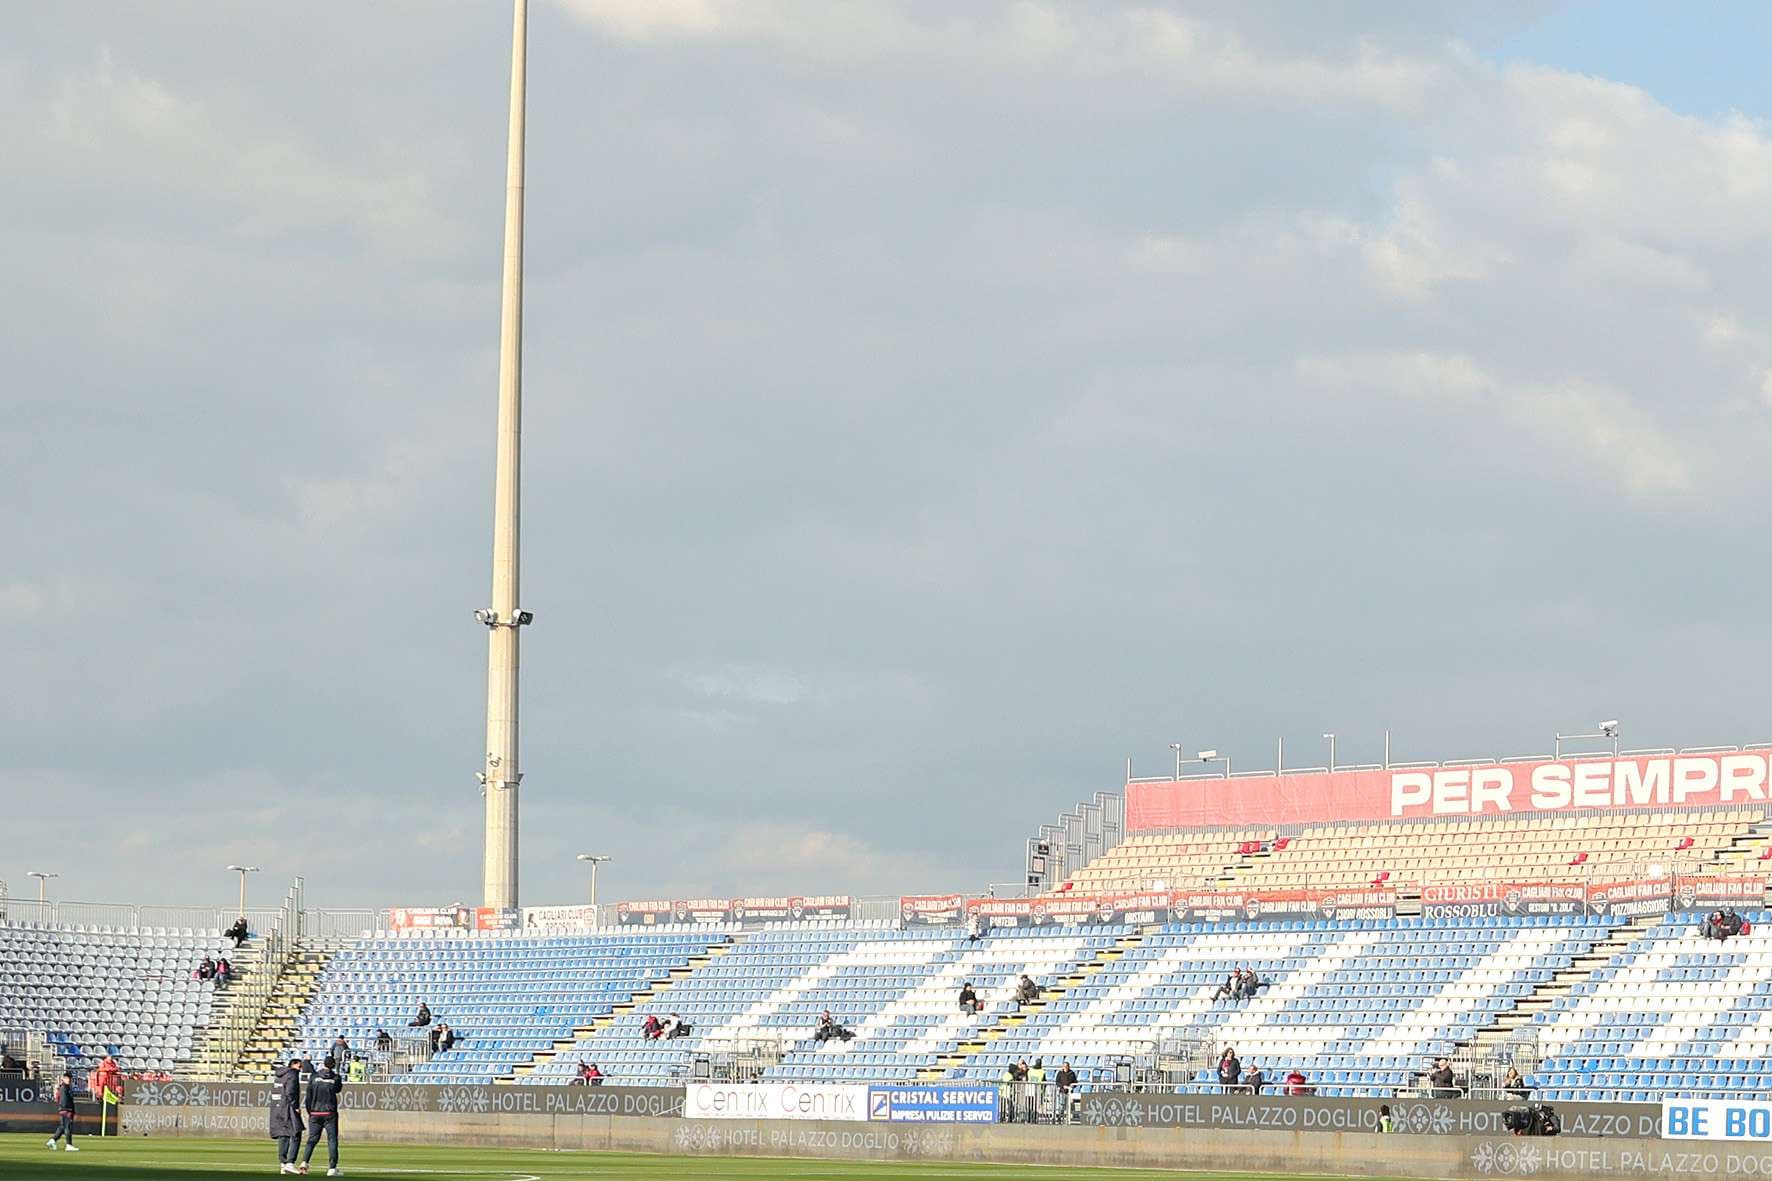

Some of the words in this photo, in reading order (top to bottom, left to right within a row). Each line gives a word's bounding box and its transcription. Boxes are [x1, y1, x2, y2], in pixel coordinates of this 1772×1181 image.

[1390, 769, 1513, 816] PER
[1424, 886, 1497, 901] GIURISTI
[1424, 904, 1497, 919] ROSSOBLU
[212, 1092, 252, 1107] HOTEL
[337, 1092, 377, 1108] OGLIO
[492, 1093, 541, 1111] HOTEL
[545, 1094, 619, 1113] PALAZZO
[624, 1095, 686, 1115] DOGLIO
[891, 1090, 938, 1105] CRISTAL
[942, 1091, 993, 1105] SERVICE
[157, 1113, 188, 1128] HOTEL
[191, 1114, 239, 1130] PALAZZO
[240, 1115, 270, 1131] DOGL
[891, 1110, 924, 1121] IMPRESA
[925, 1110, 954, 1121] PULIZIE
[955, 1111, 961, 1121] E
[963, 1110, 993, 1121] SERVIZI
[1148, 1104, 1205, 1123] HOTEL
[1211, 1105, 1297, 1126] PALAZZO
[1304, 1107, 1378, 1129] DOGLIO
[1459, 1111, 1502, 1131] HOT
[1560, 1113, 1631, 1135] LAZZO
[1668, 1106, 1709, 1137] BE
[724, 1129, 765, 1146] HOTEL
[771, 1131, 836, 1148] PALAZZO
[842, 1133, 899, 1150] DOGLIO
[1547, 1149, 1608, 1169] HOTEL
[1621, 1150, 1718, 1174] PALAZZO
